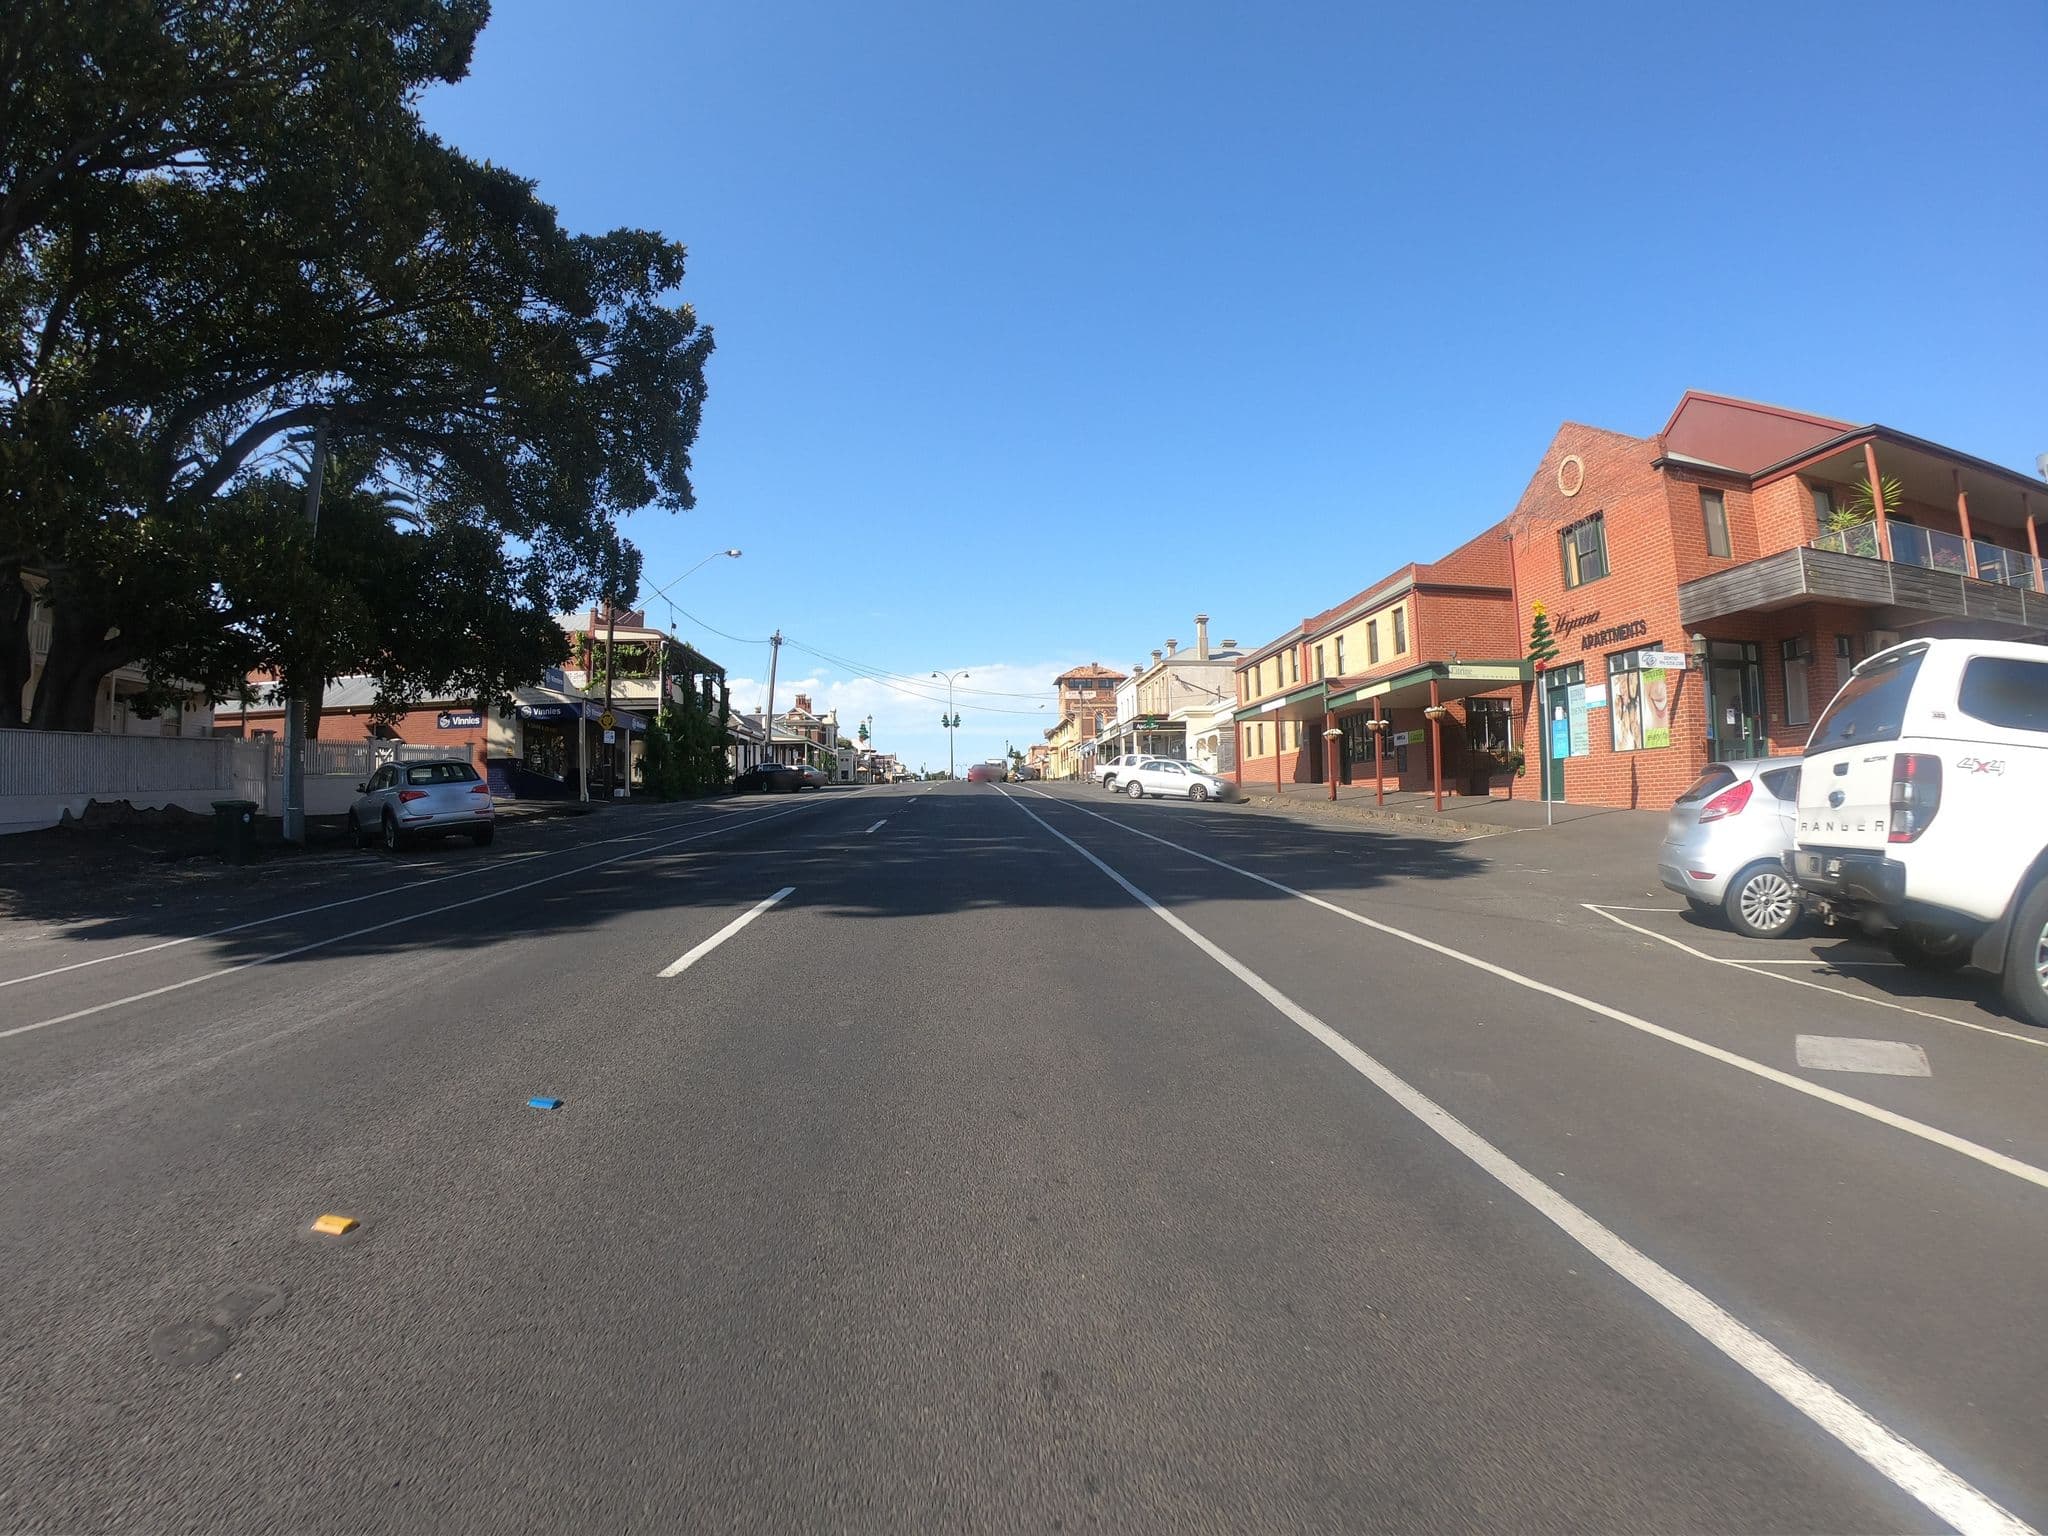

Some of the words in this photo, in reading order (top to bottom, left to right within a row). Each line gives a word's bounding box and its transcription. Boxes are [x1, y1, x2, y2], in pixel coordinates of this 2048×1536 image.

[1582, 619, 1647, 650] APARTMENTS
[533, 706, 561, 716] Vinnies
[452, 716, 480, 725] Vinnies
[1801, 820, 1885, 832] RANGER
